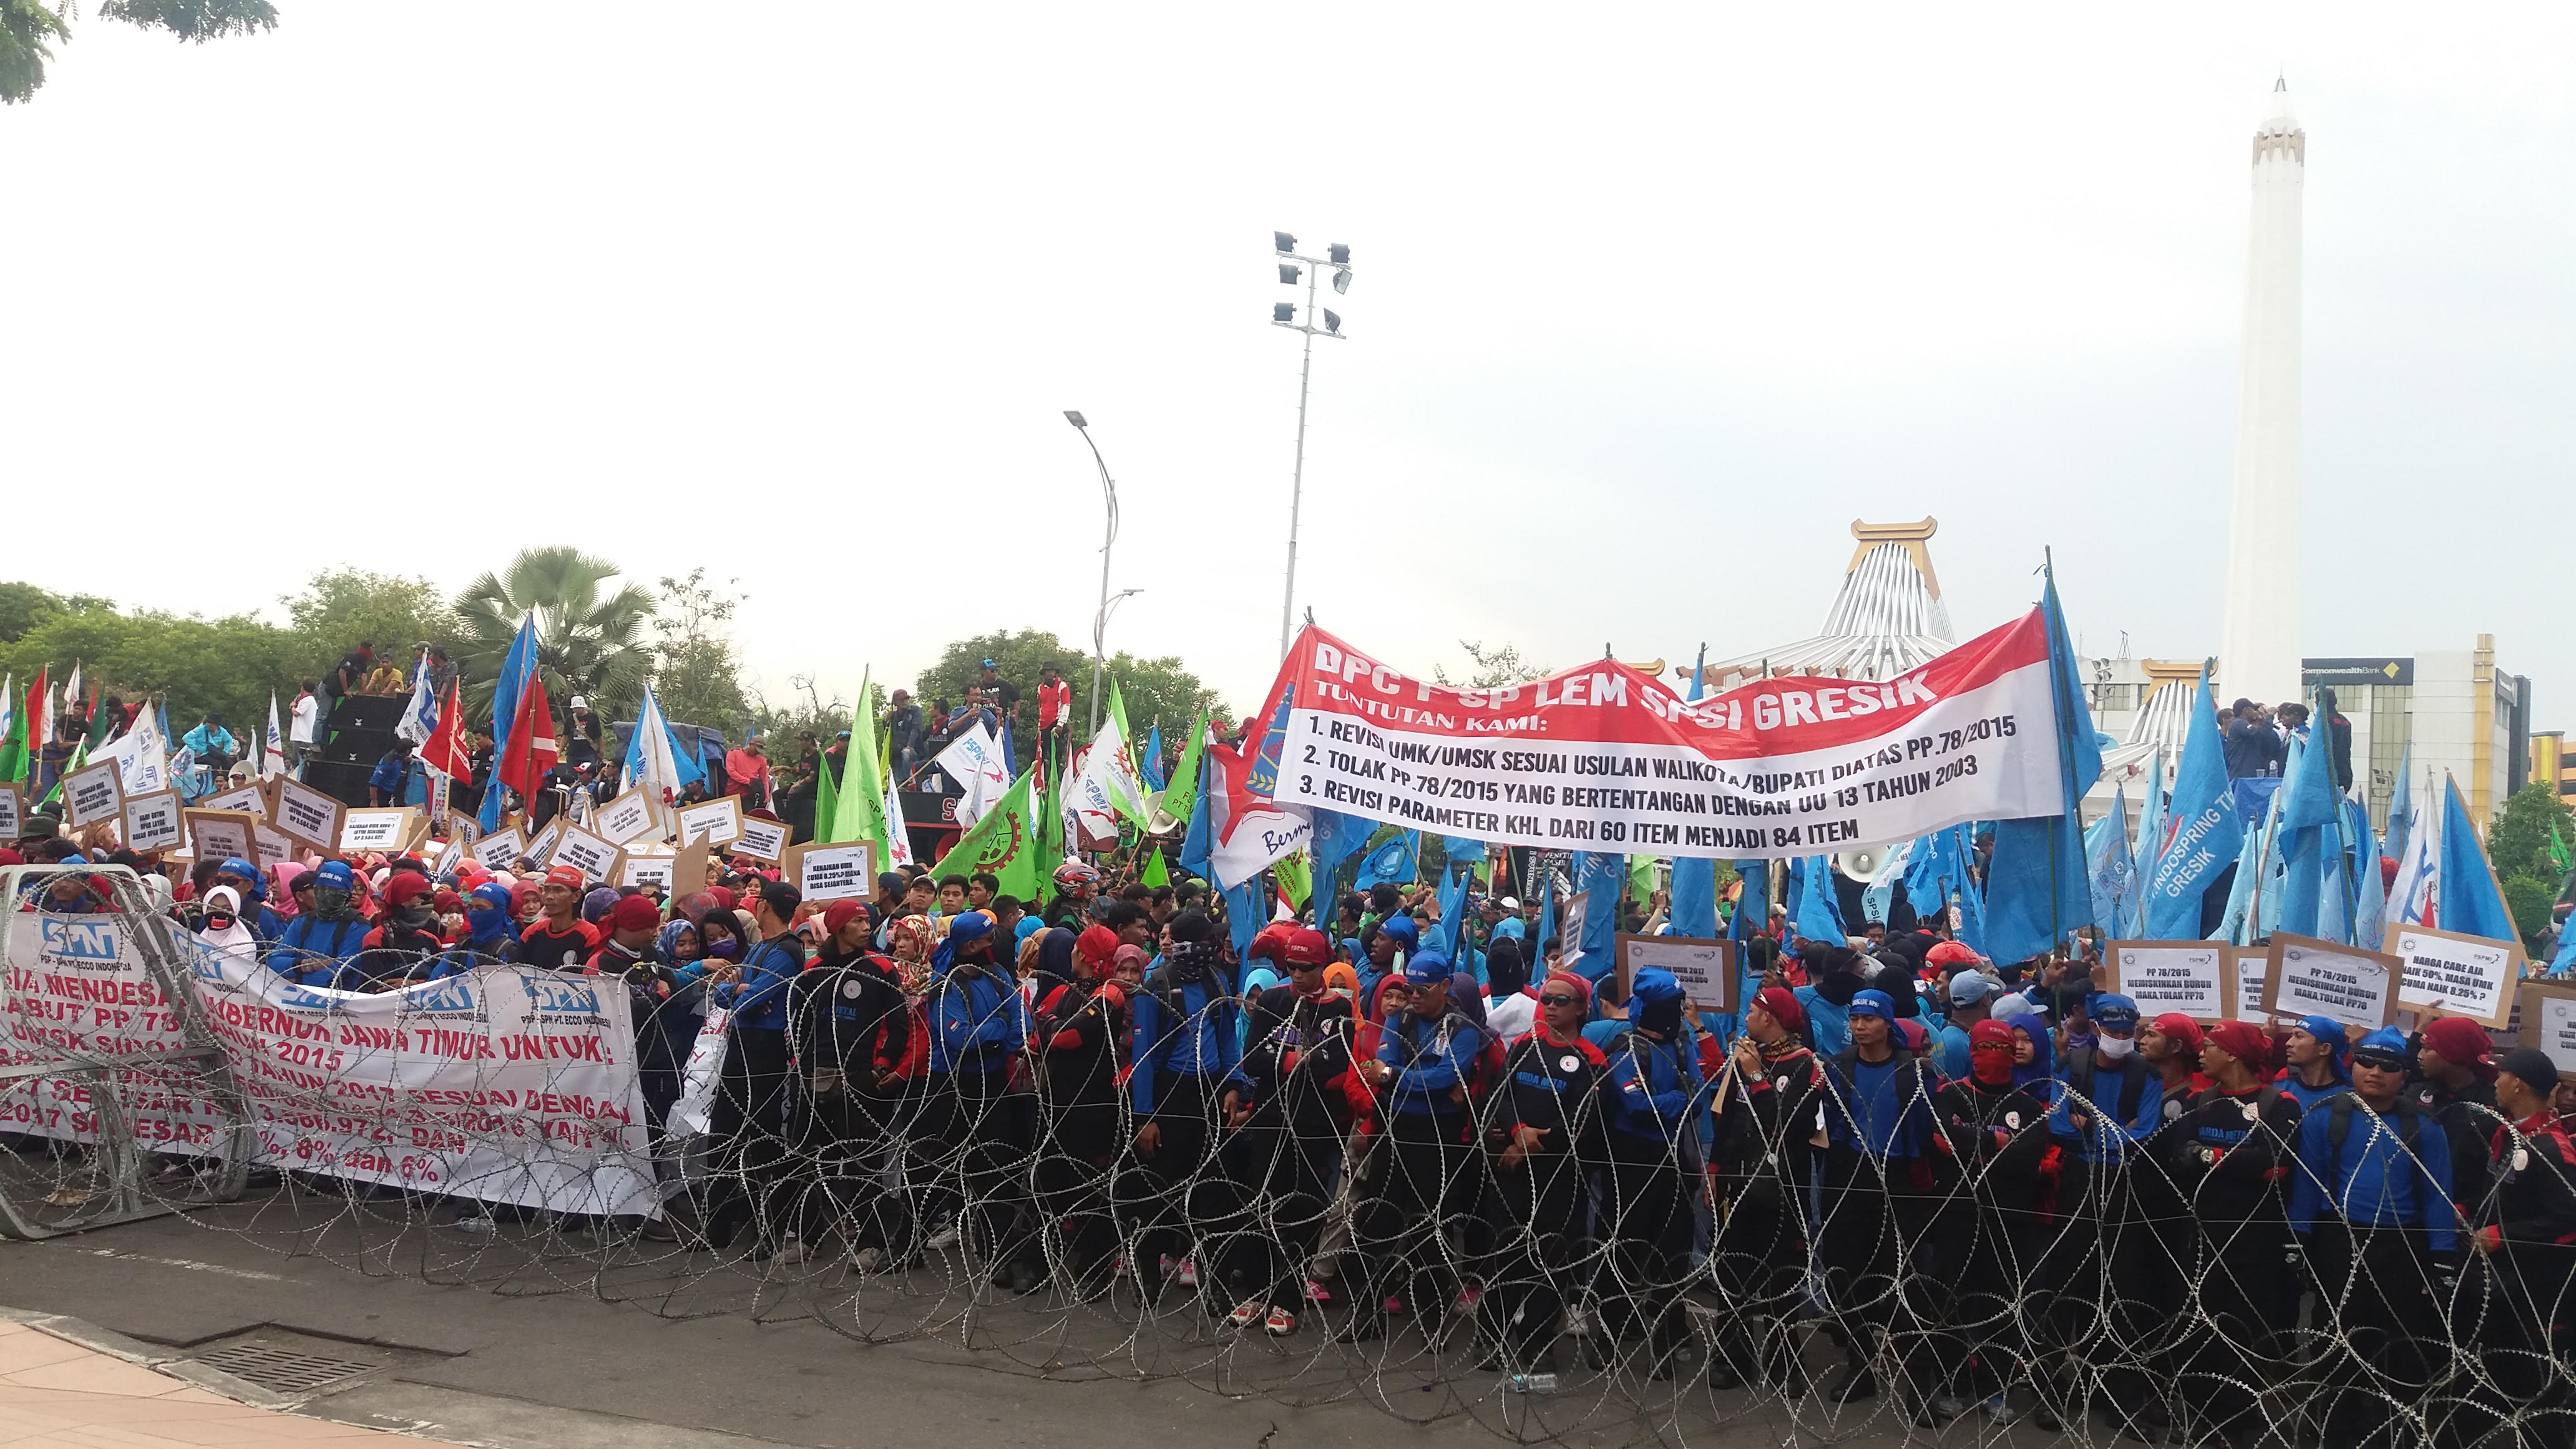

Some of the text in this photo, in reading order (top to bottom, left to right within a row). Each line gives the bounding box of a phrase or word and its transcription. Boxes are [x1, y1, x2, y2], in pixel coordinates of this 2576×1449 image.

[1314, 642, 1401, 695] DPC
[1458, 686, 1520, 710] SP
[1534, 673, 1627, 708] LEM
[1641, 685, 1742, 730] SPSI
[1753, 669, 1938, 730] GRESIK
[1314, 680, 1548, 731] TUNTUTAN KAMI:
[1309, 715, 2016, 795] 1. REVISI UMK/UMSK SESUAI USULAN WALIKOTA/BUPATI DIATAS PP.78/2015
[1303, 744, 1320, 765] 2.
[1329, 749, 1387, 781] TOLAK
[1391, 766, 1498, 801] PP.78/2015
[1504, 783, 1555, 805] YANG
[1562, 786, 1705, 814] BERTENTANGAN
[1711, 794, 1791, 816] DENGAN
[1798, 793, 1827, 812] UU
[1833, 786, 1858, 807] 13
[1863, 771, 1930, 803] TAHUN
[1935, 754, 1978, 787] 2003
[1299, 775, 1858, 849] 3. REVISI PARAMETER KHL DARI 60 ITEM MENJADI 84 ITEM
[812, 864, 840, 872] KENAIKAN
[845, 869, 861, 878] MANA
[2166, 846, 2217, 898] GRESIK
[809, 882, 823, 890] BISA
[42, 918, 115, 959] SPN
[77, 960, 94, 971] ECCO
[2147, 968, 2192, 977] PP 78/2015
[2310, 967, 2321, 978] PP
[2413, 955, 2484, 977] HARGA CABE AJA
[2127, 979, 2212, 988] MEMISKINKAN BURUH
[2401, 977, 2426, 990] CUMA
[2427, 982, 2449, 995] NAIK
[2445, 973, 2471, 987] MASA
[2472, 978, 2494, 991] UMK
[2185, 991, 2205, 1000] PP78
[2347, 987, 2378, 1000] BURUH
[565, 1015, 582, 1025] ECCO
[1, 996, 344, 1071] ABUT PP 78 2015
[340, 1025, 409, 1052] JAWA
[414, 1029, 497, 1061] TIMUR
